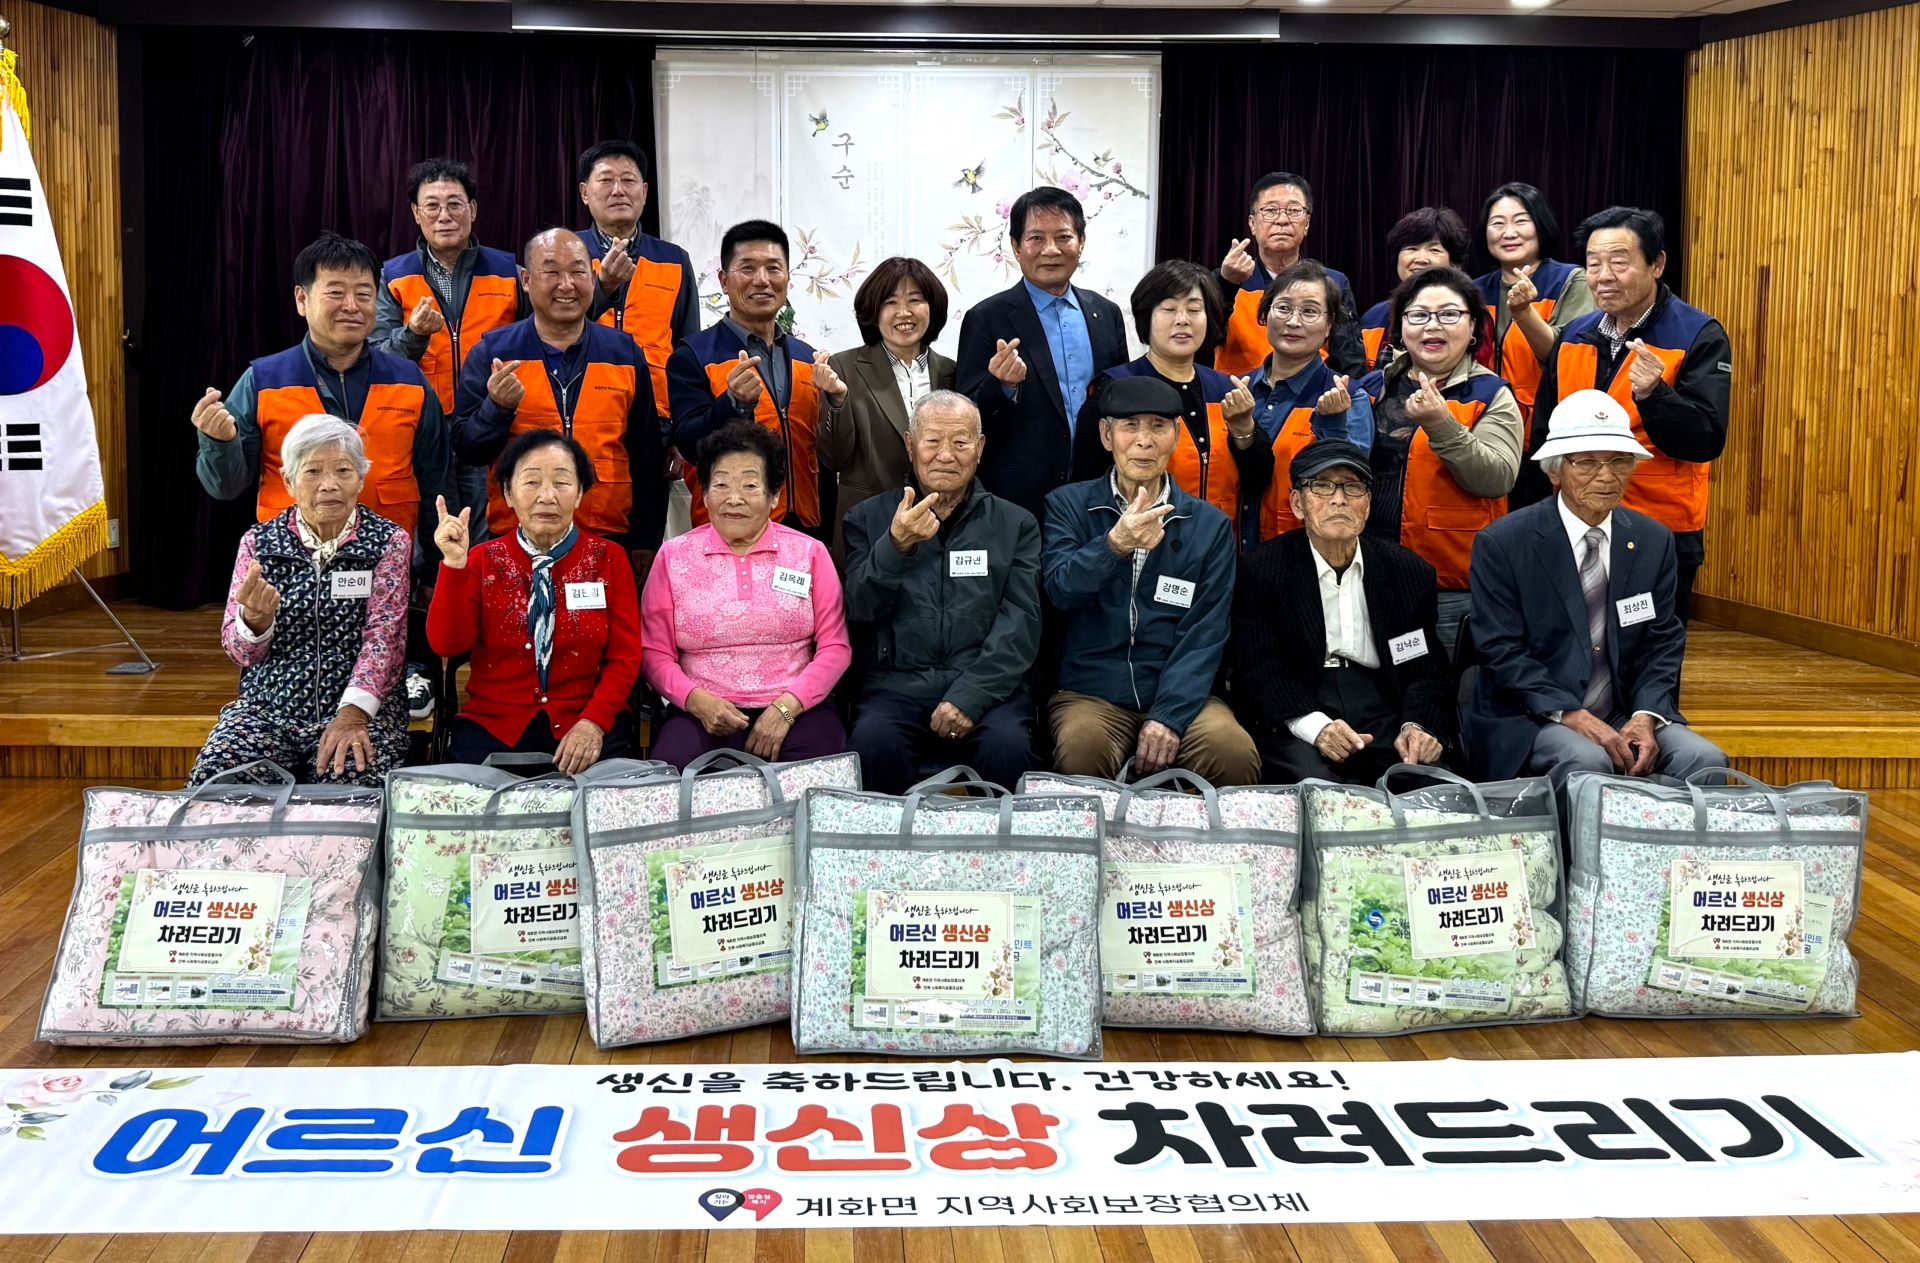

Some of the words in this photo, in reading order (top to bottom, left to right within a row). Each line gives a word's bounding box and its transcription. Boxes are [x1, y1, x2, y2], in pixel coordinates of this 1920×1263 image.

[338, 576, 366, 588] 안순이
[1624, 599, 1648, 614] 최상진
[494, 881, 540, 900] 어르신
[546, 878, 578, 896] 생신
[691, 886, 736, 909] 어르신
[740, 878, 784, 901] 생신상
[1428, 886, 1467, 905] 어르신
[1471, 881, 1508, 900] 생신상
[1693, 891, 1736, 907] 어르신
[1741, 892, 1785, 907] 생신상
[154, 901, 202, 918] 어르신
[207, 902, 257, 919] 생신상
[701, 903, 777, 934] 차려드리기
[1117, 901, 1162, 919] 어르신
[1168, 899, 1215, 918] 생신상
[1439, 906, 1503, 929] 차려드리기
[1701, 914, 1774, 931] 차려드리기
[157, 925, 241, 944] 차려드리기
[890, 924, 936, 942] 어르신
[942, 924, 991, 942] 생신상
[1128, 925, 1207, 944] 차려드리기
[899, 950, 979, 969] 차려드리기
[596, 1072, 745, 1093] 생신을
[763, 1067, 1071, 1093] 축하드립니다.
[1083, 1069, 1348, 1092] 건강하세요!
[93, 1105, 564, 1175] 어르신
[613, 1102, 1060, 1172] 생신상
[1098, 1094, 1864, 1169] 차려드리기
[797, 1197, 917, 1217] 계화면
[936, 1193, 1310, 1216] 지역사회보장협의체
